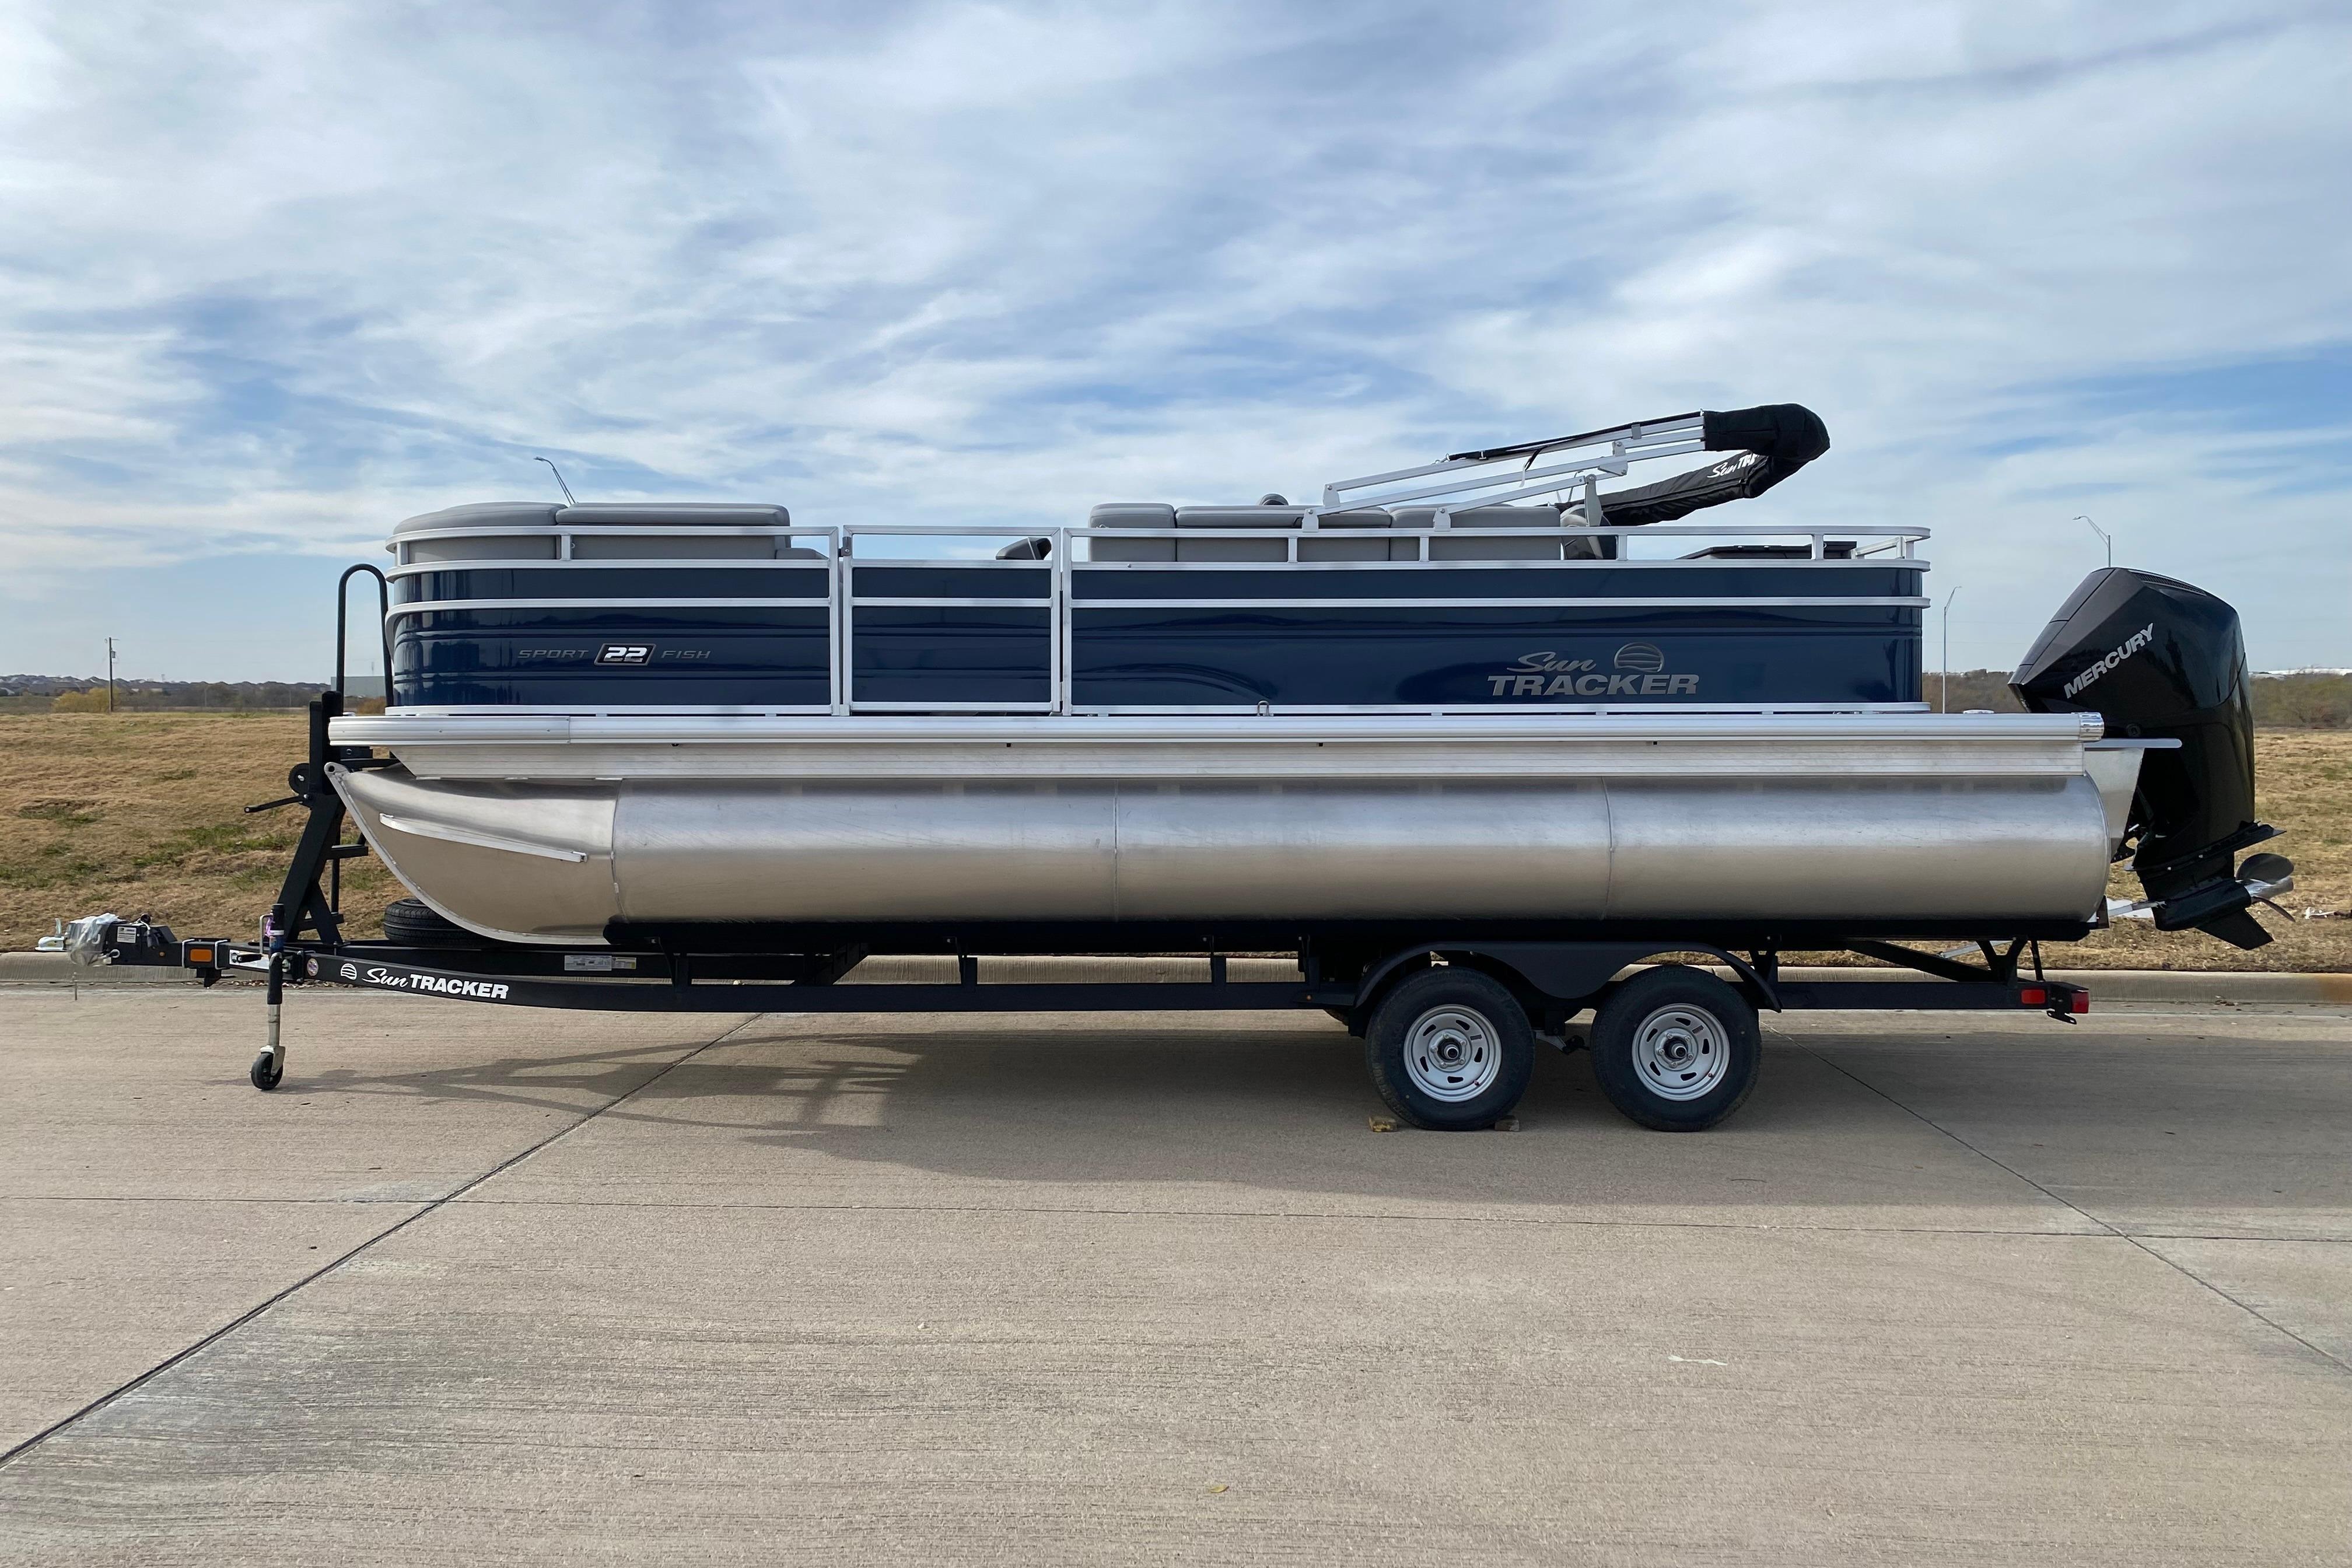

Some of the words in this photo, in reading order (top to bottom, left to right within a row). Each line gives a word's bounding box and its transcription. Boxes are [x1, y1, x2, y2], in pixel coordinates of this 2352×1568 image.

[517, 649, 589, 659] SPORT
[603, 646, 648, 662] 22
[660, 650, 711, 659] FISH
[1506, 651, 1597, 673] Sun
[2063, 622, 2154, 699] MERCURY
[1488, 674, 1700, 696] TRACKER
[361, 967, 408, 988] Sun
[410, 974, 509, 999] TRACKER
